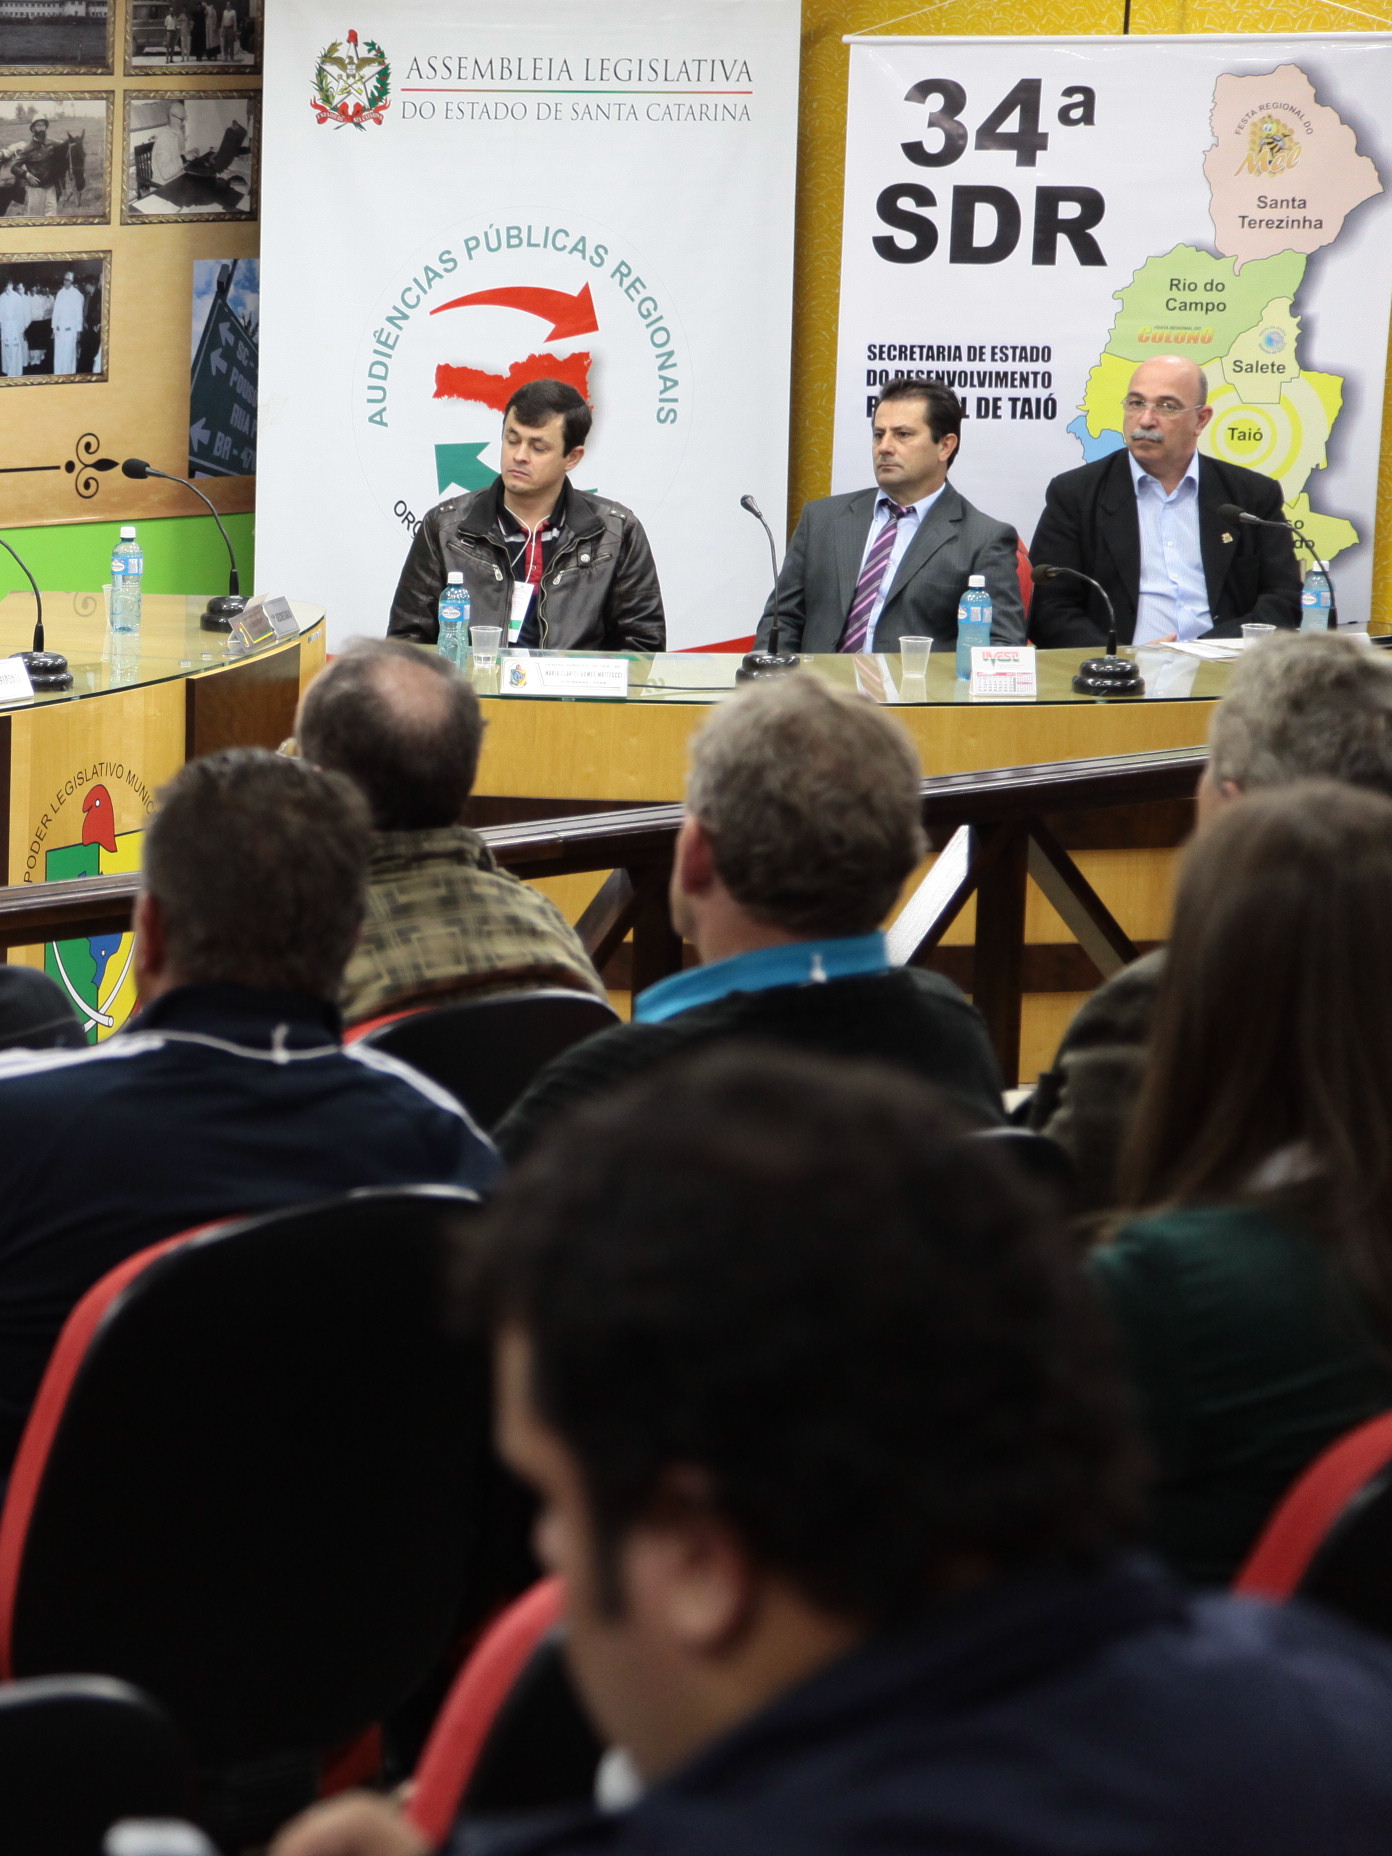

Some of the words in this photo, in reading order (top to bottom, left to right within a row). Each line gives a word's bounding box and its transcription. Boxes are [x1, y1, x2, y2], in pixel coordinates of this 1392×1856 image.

[405, 56, 573, 83] ASSEMBLEIA
[584, 57, 754, 84] LEGISLATIVA
[400, 101, 438, 121] DO
[444, 101, 528, 122] ESTADO
[538, 101, 564, 122] DE
[570, 101, 639, 122] SANTA
[645, 102, 753, 123] CATARINA
[1234, 109, 1257, 135] FESTA
[1258, 102, 1306, 121] REGIONAL
[1303, 120, 1314, 135] DO
[1234, 143, 1304, 177] Mel
[1256, 195, 1308, 211] Santa
[871, 183, 1108, 267] SDR
[1237, 214, 1324, 231] Terezinha
[1169, 277, 1199, 293] Rio
[1203, 277, 1226, 293] do
[1165, 297, 1227, 315] Campo
[366, 249, 460, 429] AUDIÊNCIAS
[463, 223, 609, 268] PÚBLICAS
[609, 260, 680, 427] REGIONAIS
[867, 343, 963, 362] SECRETARIA
[966, 345, 987, 363] DE
[990, 345, 1052, 363] ESTADO
[1232, 359, 1287, 374] Salete
[866, 368, 890, 388] DO
[976, 397, 1003, 420] DE
[1008, 393, 1058, 421] TAIÓ
[213, 431, 232, 460] BR
[1227, 426, 1264, 443] Taió
[23, 815, 52, 883] PODER
[50, 761, 124, 814] LEGISLATIVO
[125, 769, 155, 815] MUNIC
